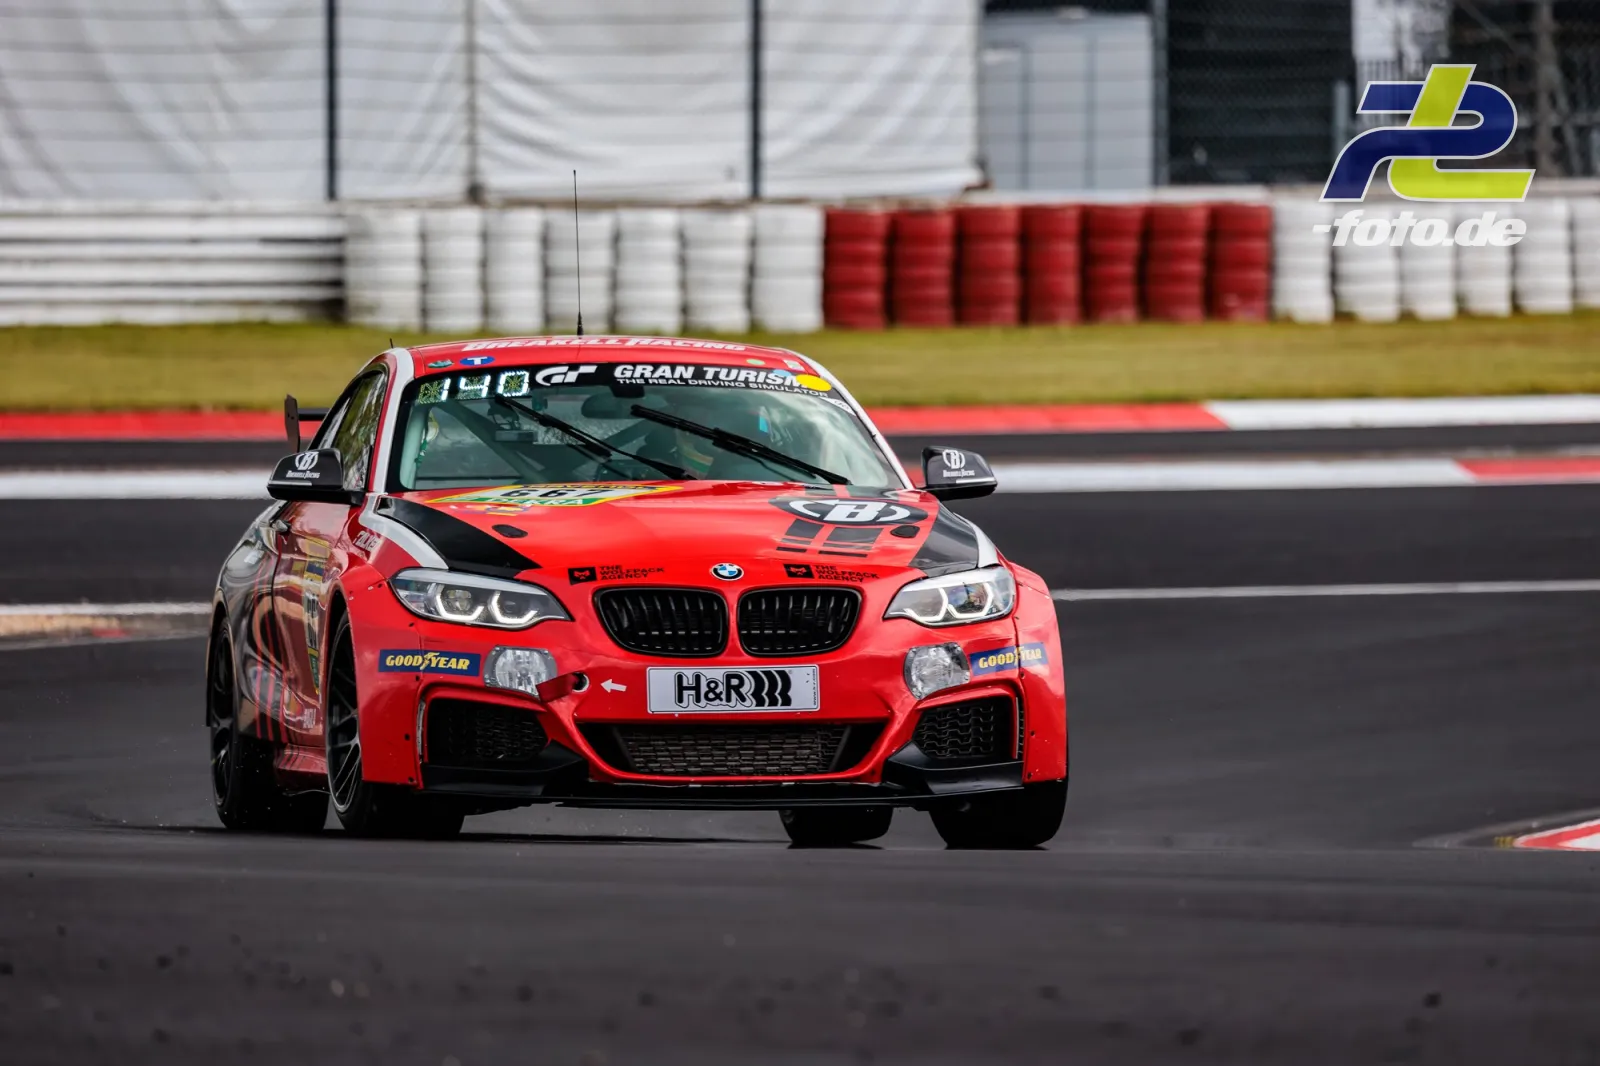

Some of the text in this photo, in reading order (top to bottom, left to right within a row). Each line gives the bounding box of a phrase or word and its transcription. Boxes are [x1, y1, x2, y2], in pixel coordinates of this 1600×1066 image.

[624, 338, 746, 351] RACING
[440, 370, 530, 401] 140
[613, 364, 808, 389] GRAN TURISM
[688, 380, 746, 388] DRIVING
[749, 383, 829, 398] SIMULATOR
[500, 489, 615, 498] 667
[600, 567, 664, 575] WOLFPACK
[816, 569, 880, 579] WOLFPACK
[818, 574, 864, 583] AGENCY
[385, 652, 470, 670] GOODYEAR
[978, 646, 1042, 668] GOODYEAR
[675, 671, 752, 708] H&R
